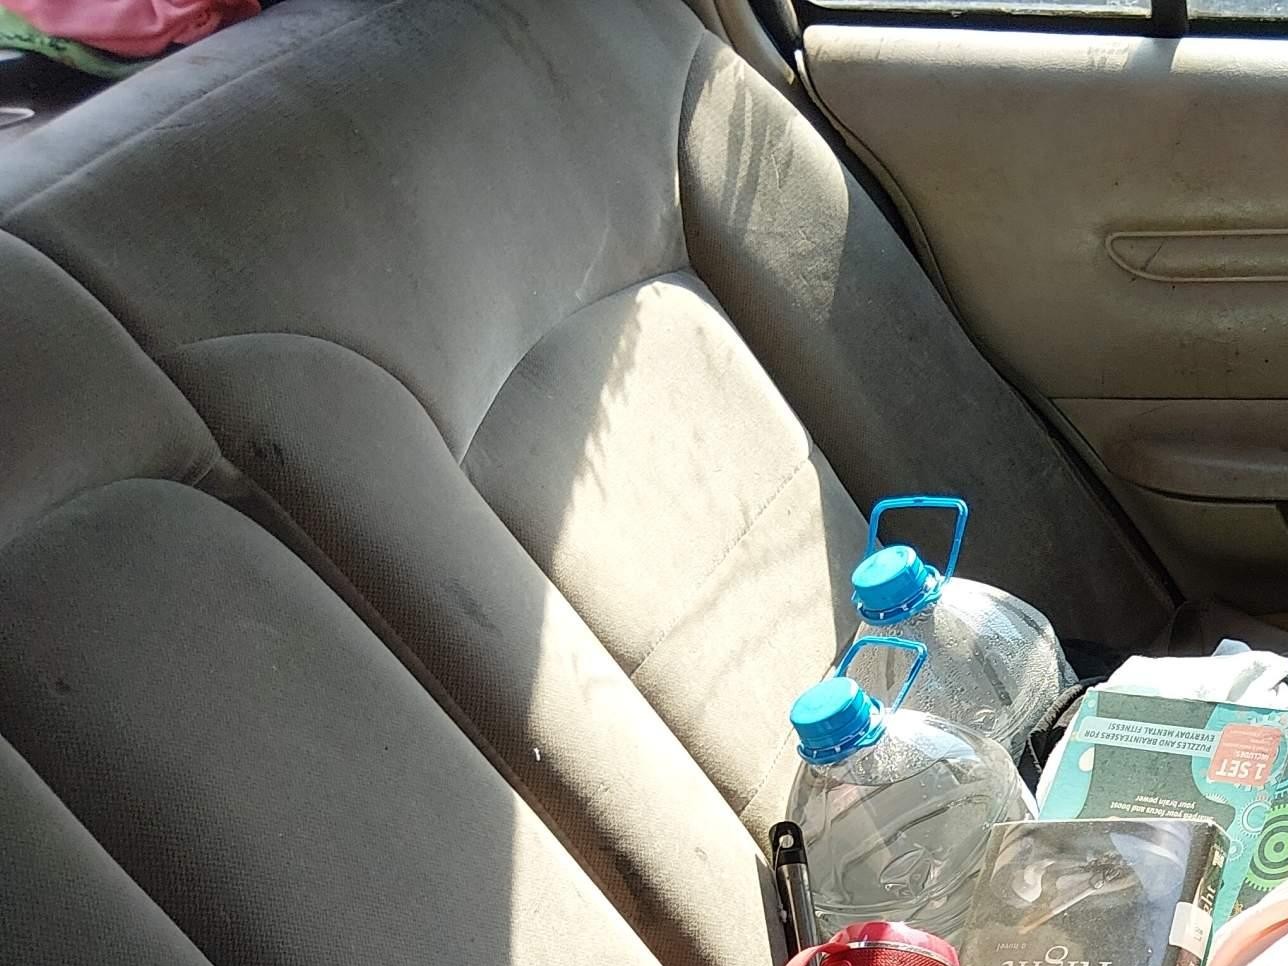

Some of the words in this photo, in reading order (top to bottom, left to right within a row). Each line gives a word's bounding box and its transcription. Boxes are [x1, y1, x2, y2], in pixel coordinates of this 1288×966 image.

[1107, 723, 1141, 733] FITNESS!
[1144, 727, 1173, 737] MENTAL
[1084, 730, 1099, 738] FOR
[1100, 732, 1158, 746] BRAINTEASERS
[1176, 732, 1216, 742] EVERYDAY
[1159, 740, 1176, 748] AND
[1176, 742, 1212, 753] PUZZLES
[1215, 758, 1251, 778] SET
[1254, 763, 1266, 780] 1
[1135, 795, 1159, 804] power
[1158, 799, 1178, 808] brain
[1110, 801, 1131, 812] boost
[1130, 805, 1146, 813] and
[1178, 801, 1196, 810] your
[1146, 806, 1165, 817] focus
[1165, 810, 1183, 818] your
[996, 943, 1020, 952] novel
